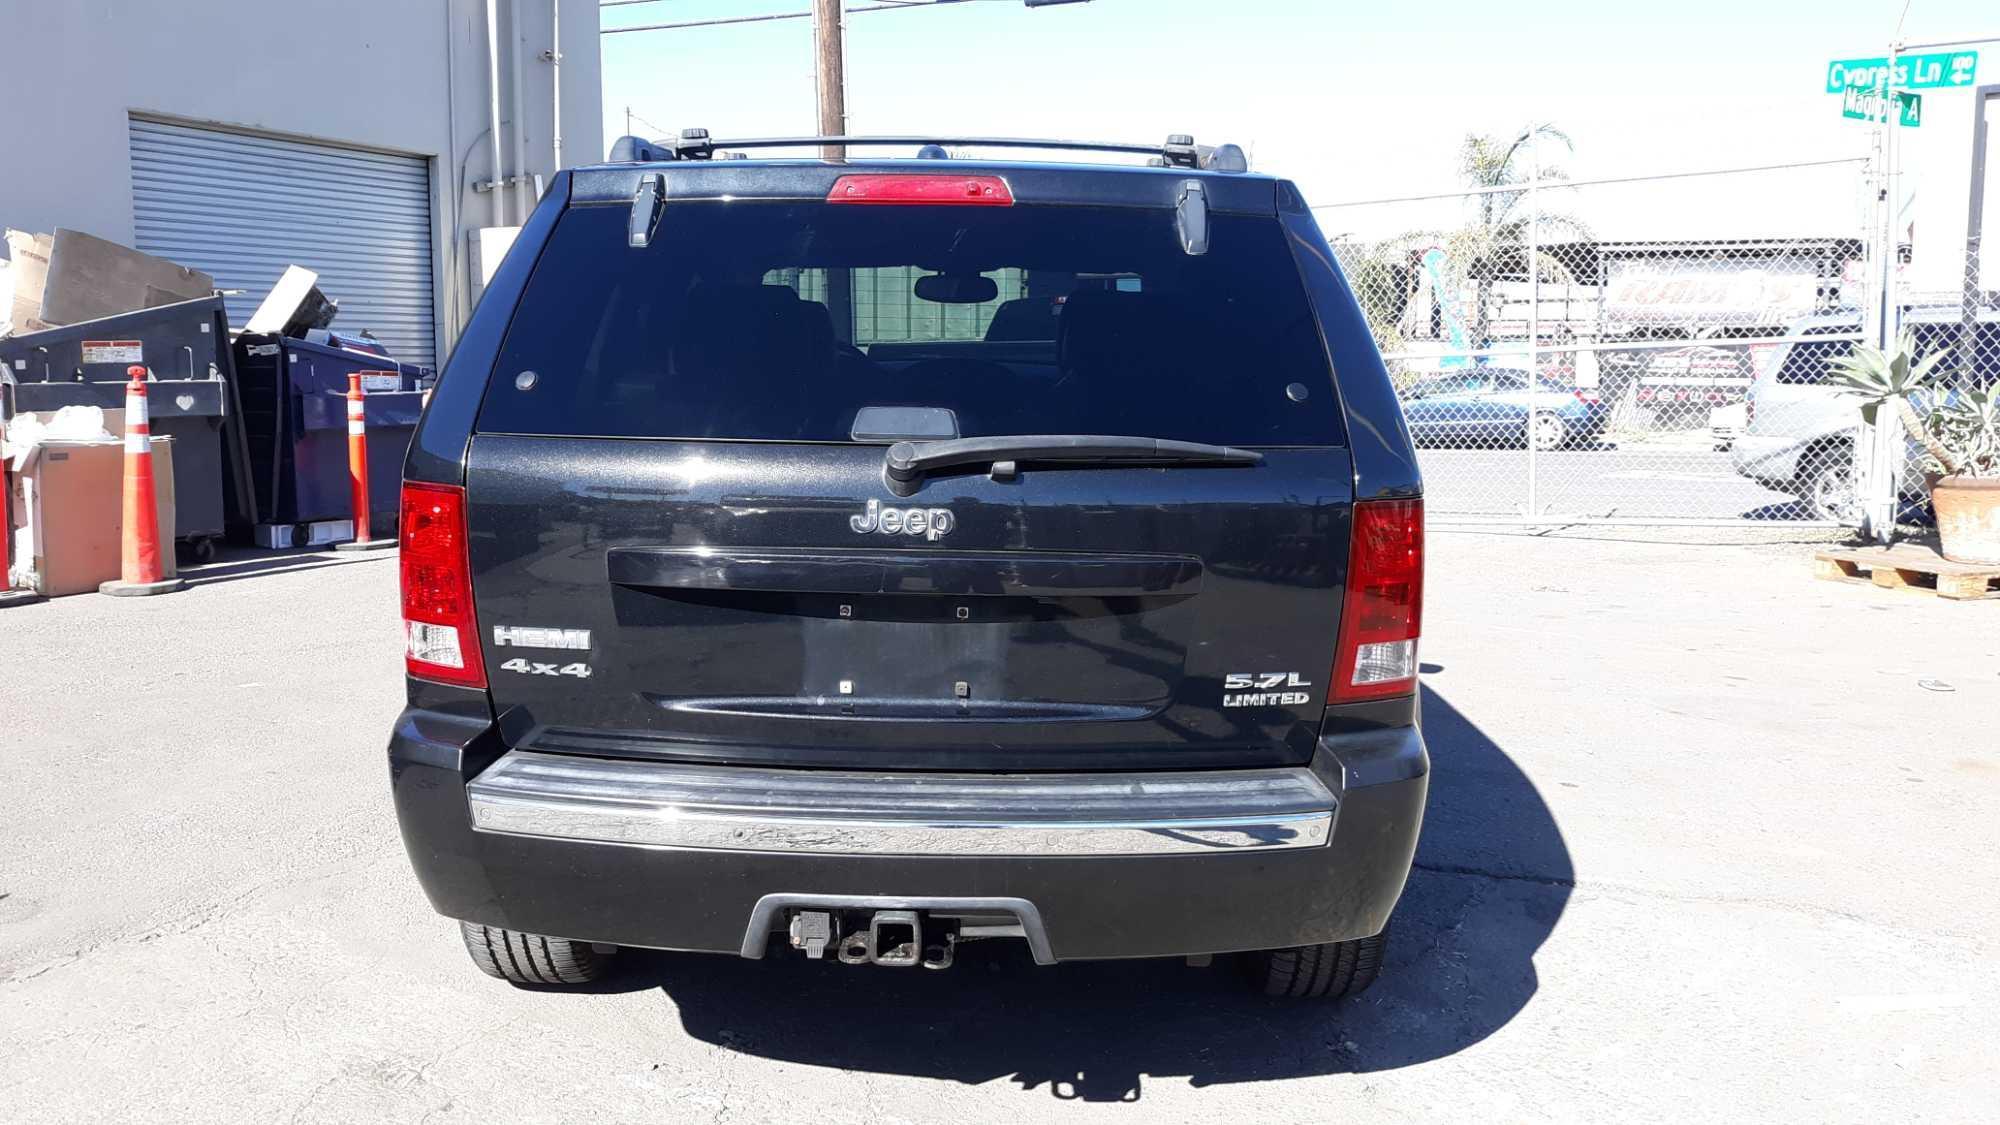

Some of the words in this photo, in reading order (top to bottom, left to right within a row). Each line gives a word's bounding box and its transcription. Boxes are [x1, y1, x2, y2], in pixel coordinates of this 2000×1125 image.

[1831, 62, 1909, 88] Cypres
[1914, 58, 1942, 83] Ln
[1845, 86, 1904, 121] Magoia
[849, 498, 955, 542] Jeep
[493, 625, 592, 650] HEMI
[500, 657, 593, 679] 4x4
[1224, 672, 1311, 688] 5.7L
[1223, 692, 1310, 707] LIMITED
